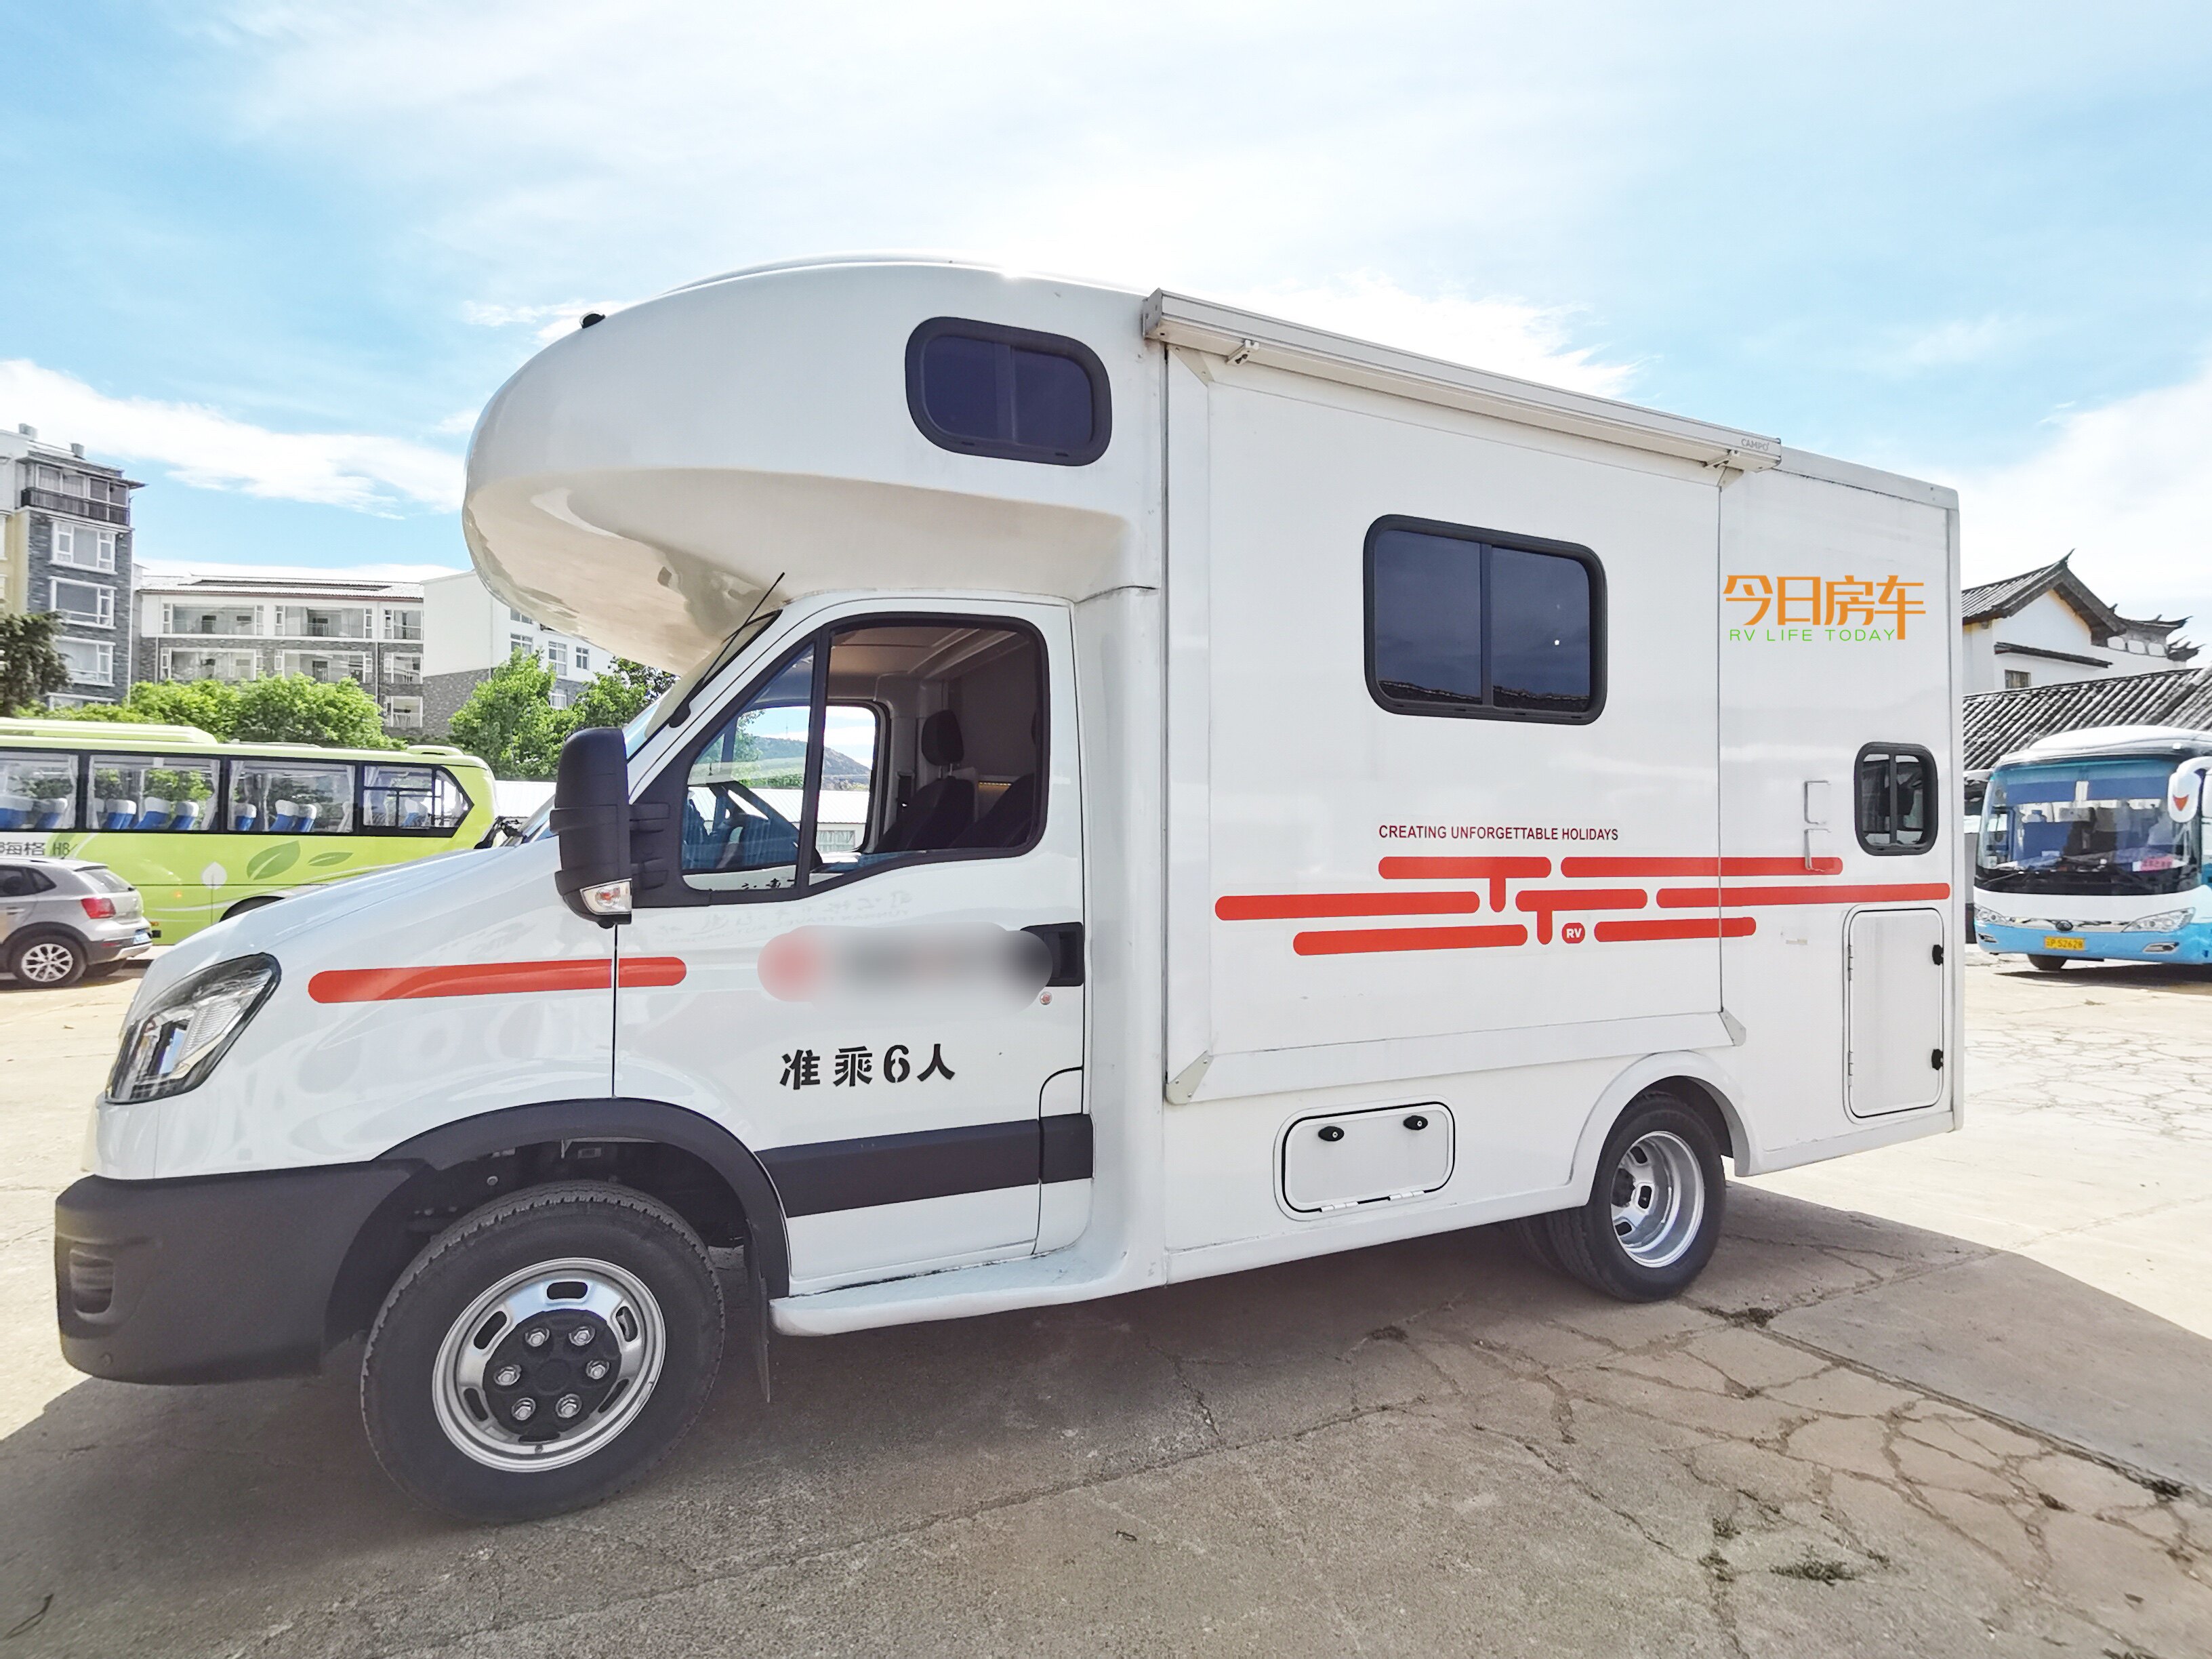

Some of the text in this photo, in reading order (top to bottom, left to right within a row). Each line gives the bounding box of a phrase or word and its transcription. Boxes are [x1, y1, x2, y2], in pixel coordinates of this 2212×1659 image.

[1378, 825, 1619, 840] CREATING UNFORGETTABLE HOLIDAYS
[1566, 928, 1582, 939] RV
[779, 1043, 956, 1090] 准乘6人
